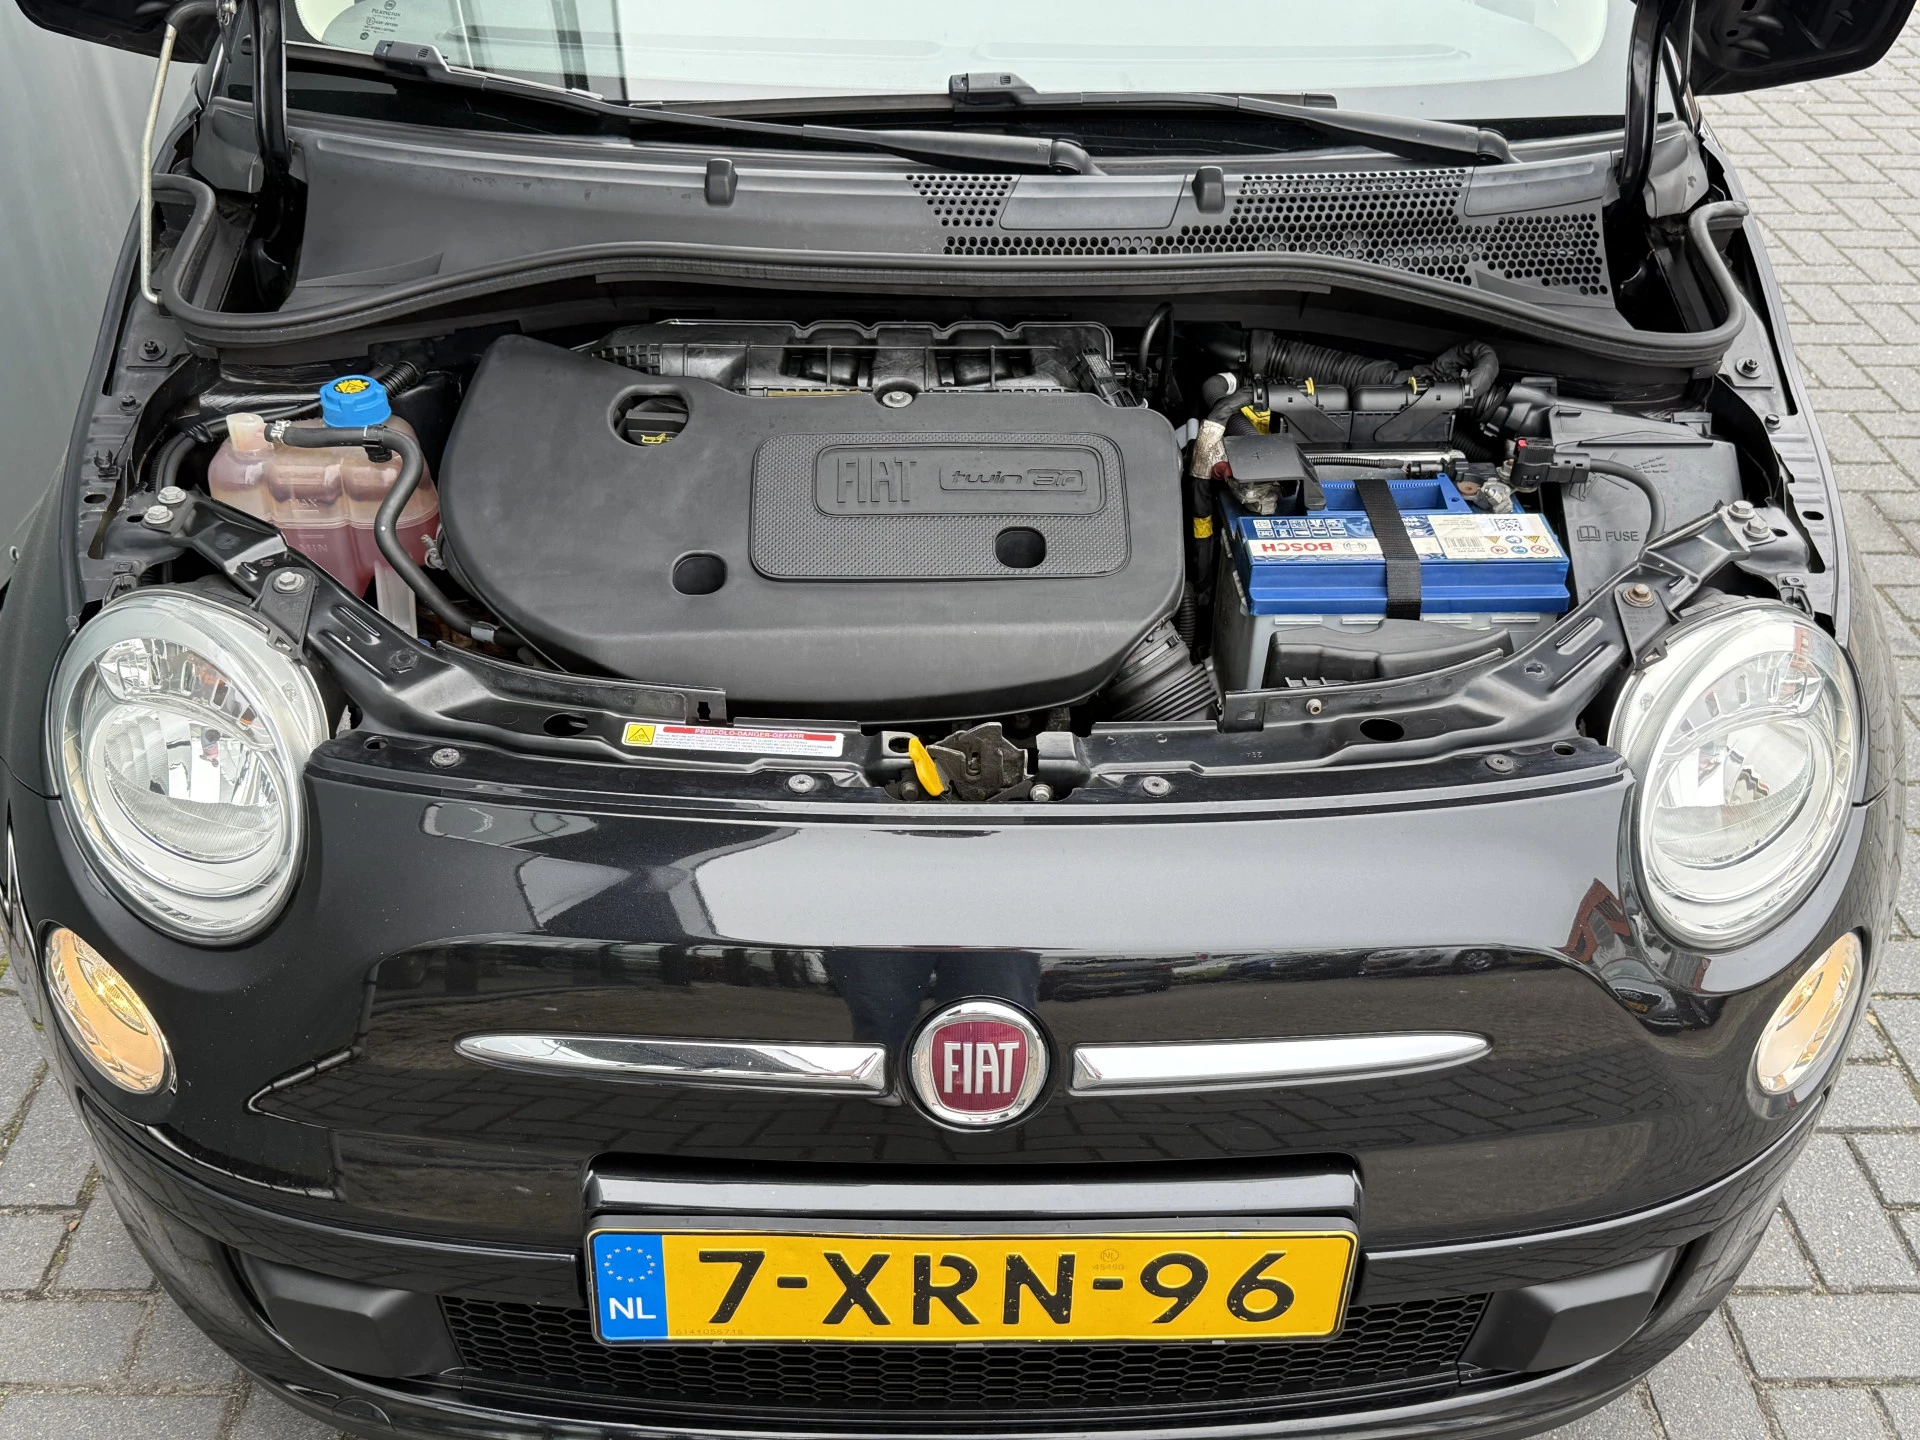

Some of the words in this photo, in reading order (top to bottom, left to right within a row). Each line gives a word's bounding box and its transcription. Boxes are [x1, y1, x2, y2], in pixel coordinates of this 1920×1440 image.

[836, 457, 917, 503] FIAT
[952, 470, 1023, 484] twin
[1032, 470, 1077, 486] air
[1261, 542, 1334, 552] BOSCH
[1605, 530, 1640, 542] FUSE
[943, 1041, 1020, 1094] FIAT
[698, 1250, 1295, 1325] 7-XRN-96
[608, 1296, 657, 1320] NL
